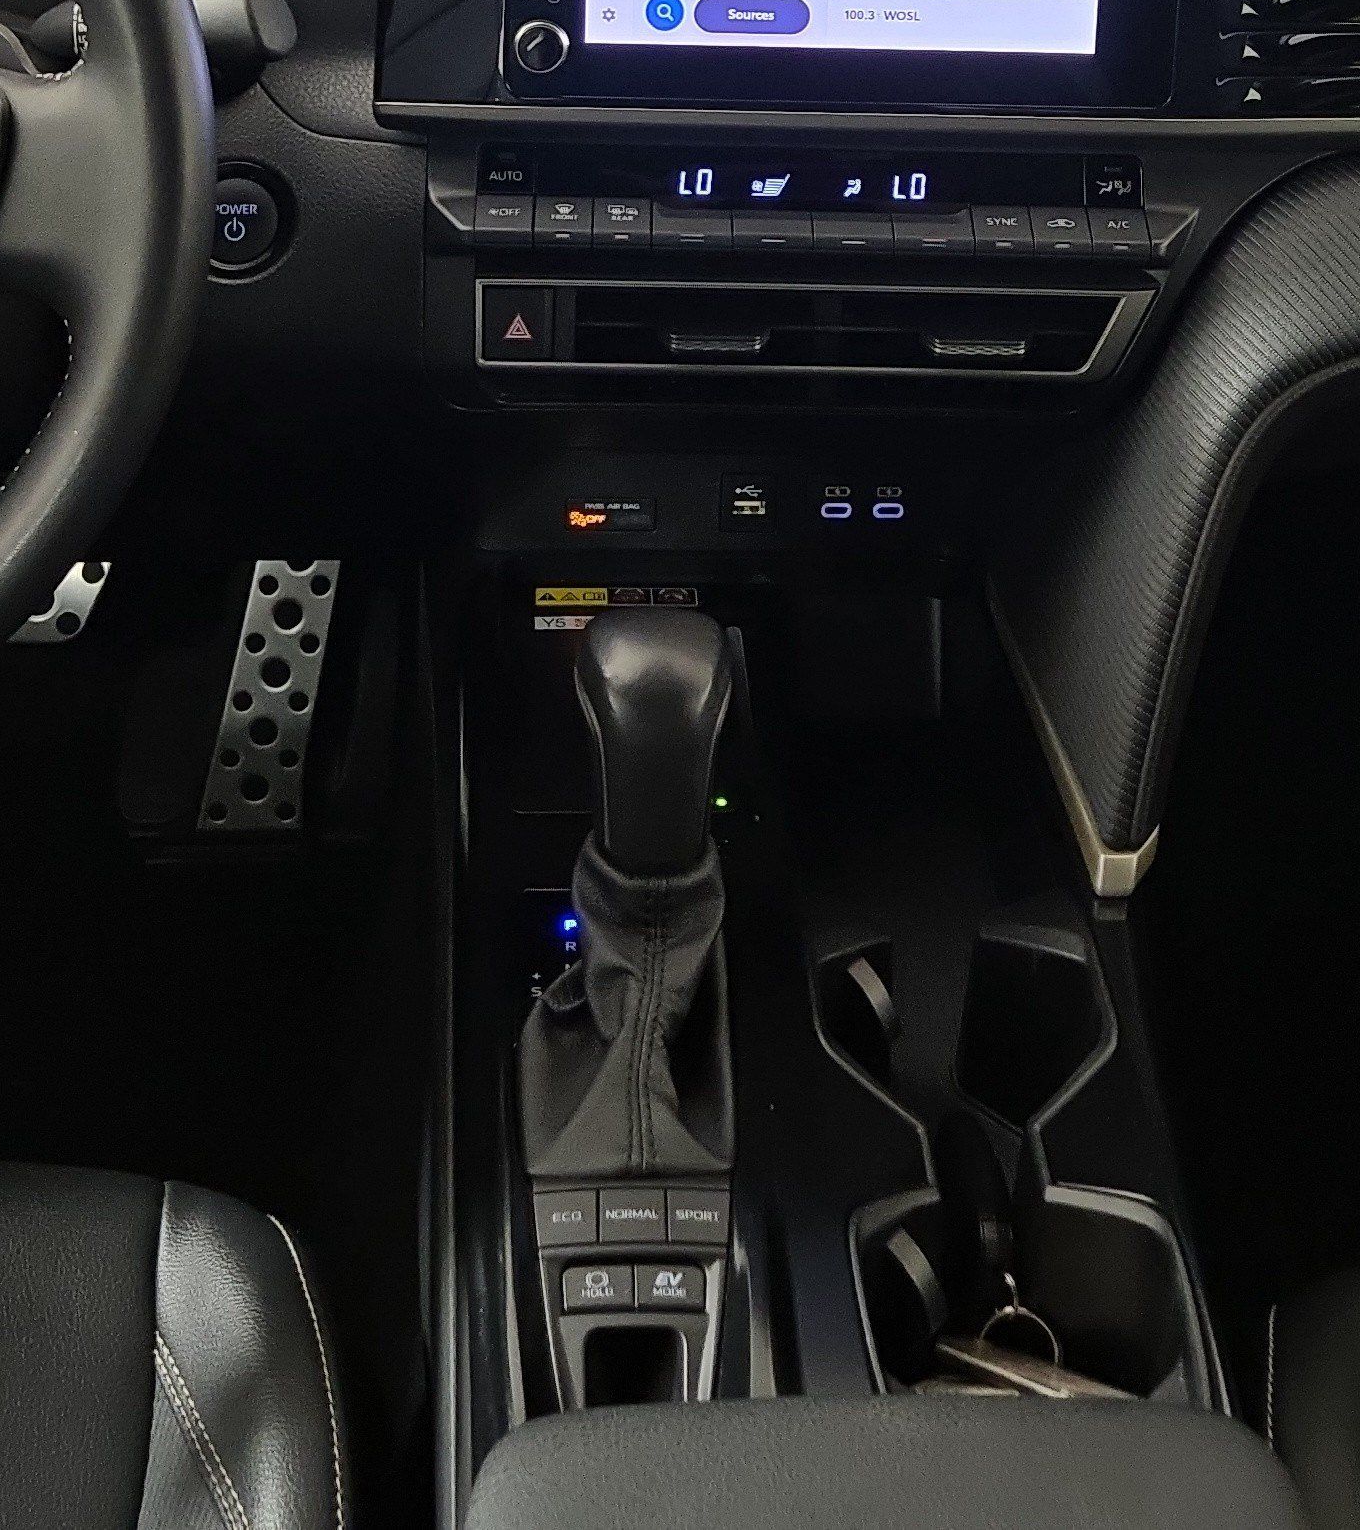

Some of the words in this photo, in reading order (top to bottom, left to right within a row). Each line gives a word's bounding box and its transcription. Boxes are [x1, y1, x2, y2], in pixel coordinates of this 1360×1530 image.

[727, 8, 776, 21] Sources
[844, 9, 876, 20] 100.3
[883, 10, 921, 21] WOSL
[489, 171, 523, 182] AUTO
[498, 207, 521, 217] OFF
[550, 213, 578, 221] FRONT
[985, 216, 1019, 226] SYNC
[1107, 220, 1131, 229] A/C
[563, 919, 578, 932] P
[565, 941, 577, 951] R
[552, 1210, 583, 1223] ECO
[605, 1208, 659, 1221] NORMAL
[674, 1209, 720, 1223] SPORT
[580, 1286, 615, 1299] HOLD
[652, 1286, 687, 1298] MODE
